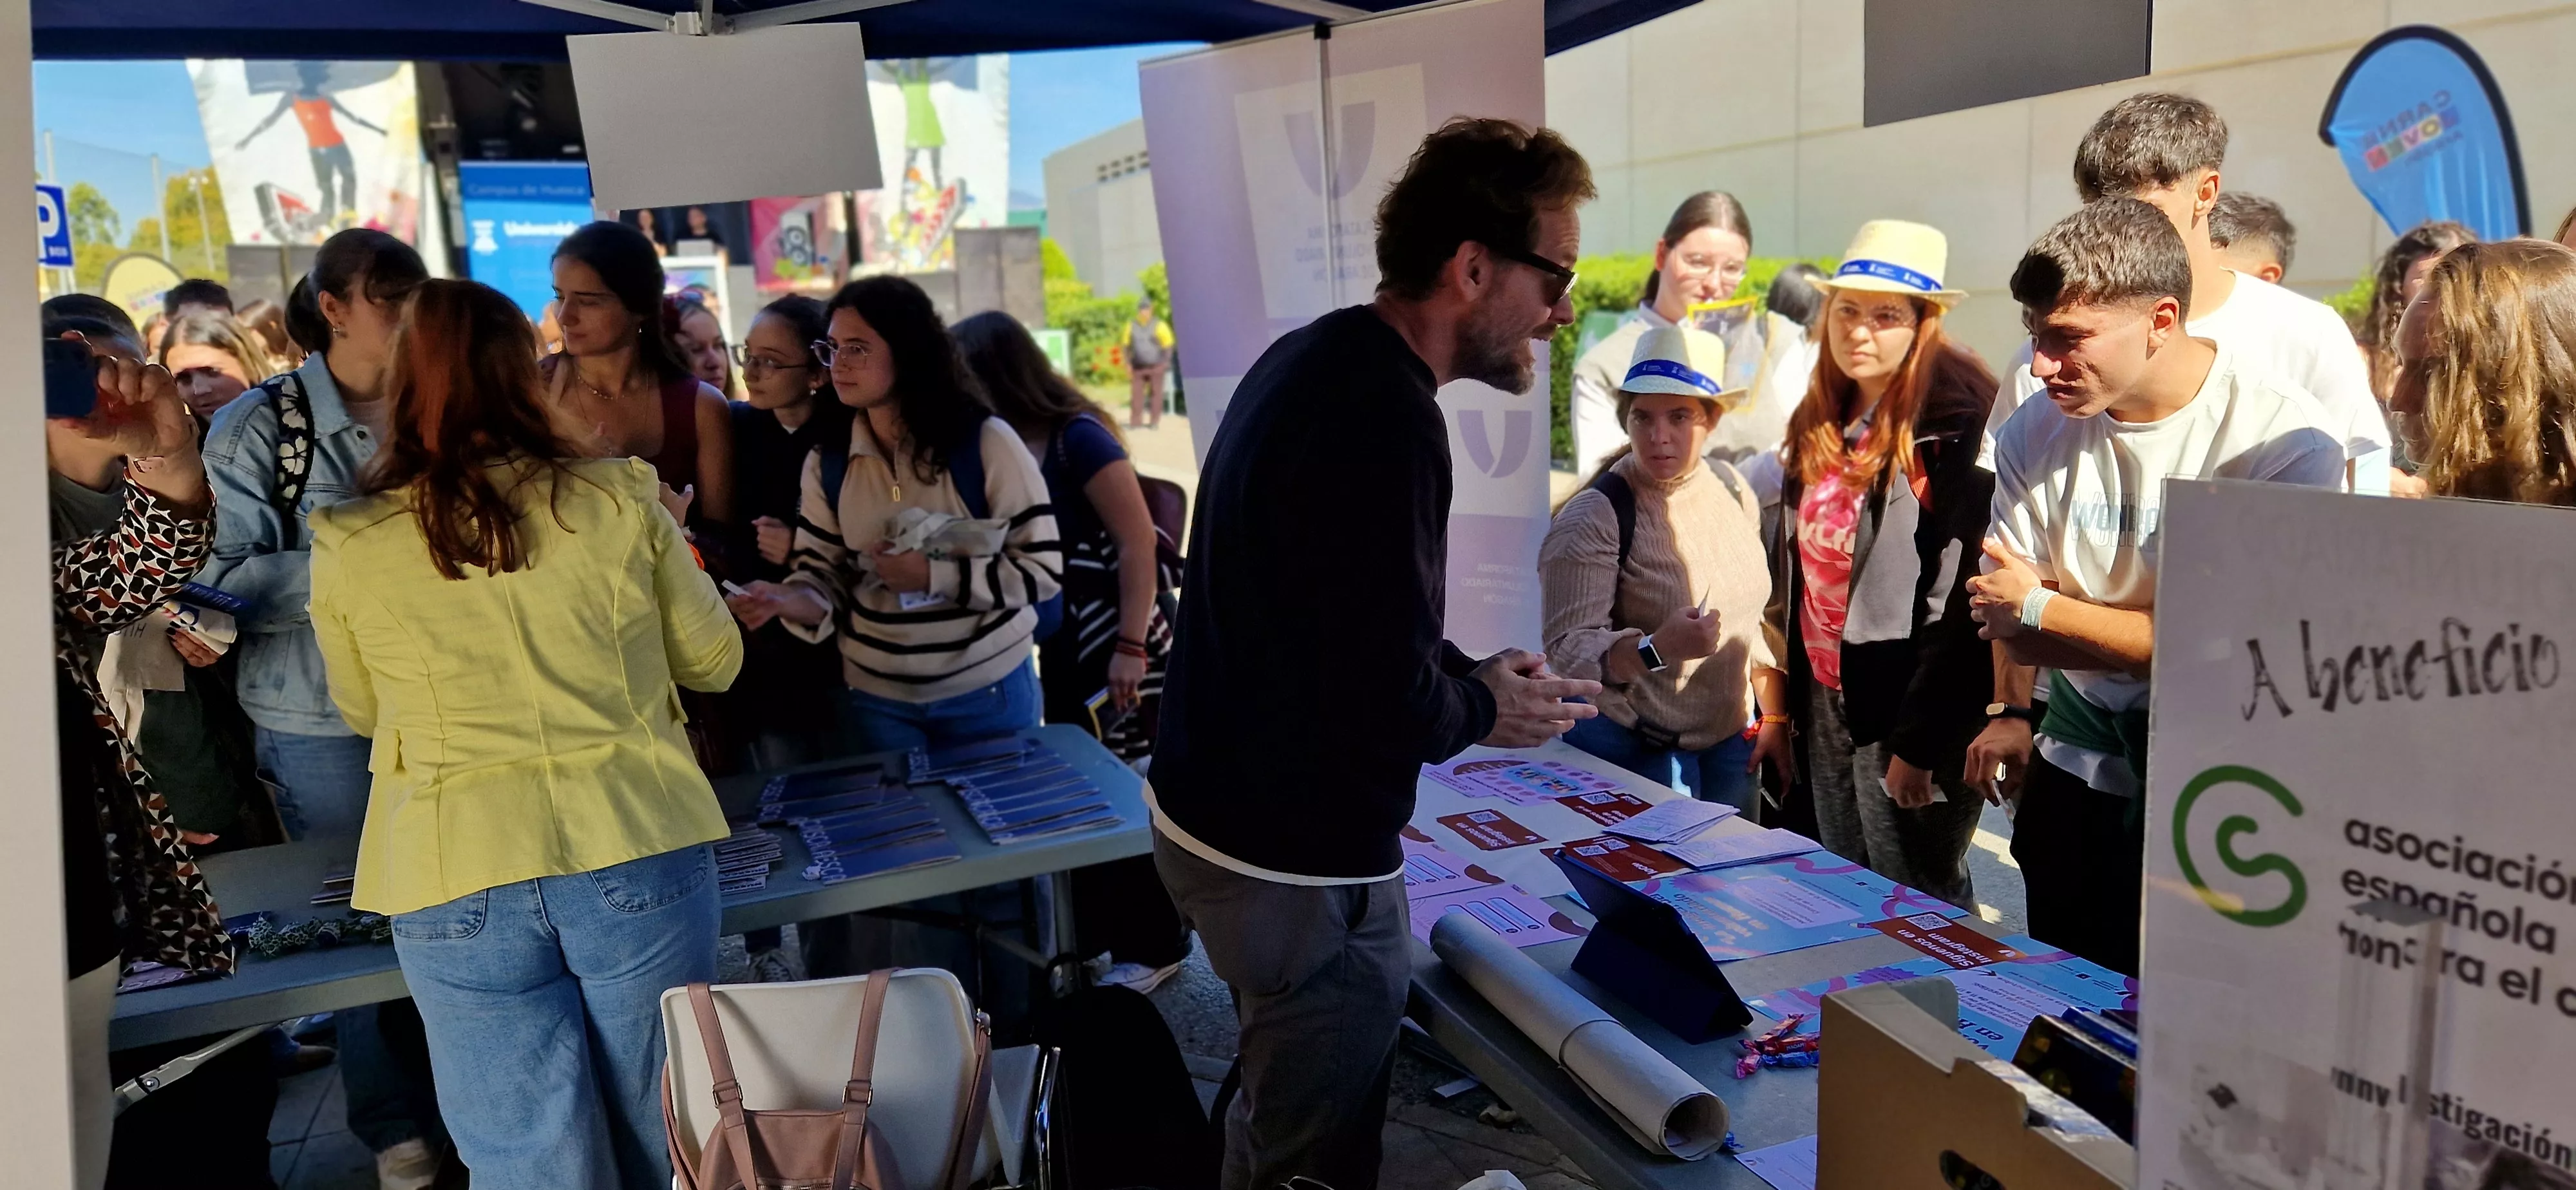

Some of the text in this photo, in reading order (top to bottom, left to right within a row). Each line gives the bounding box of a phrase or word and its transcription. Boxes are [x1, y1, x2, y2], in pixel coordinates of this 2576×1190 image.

[36, 191, 60, 259] P
[2241, 617, 2560, 721] A beneficio
[1897, 929, 1975, 967] Síguenos en
[1927, 932, 1993, 963] Instagram
[2499, 967, 2541, 1006] el
[1975, 1026, 2005, 1041] en
